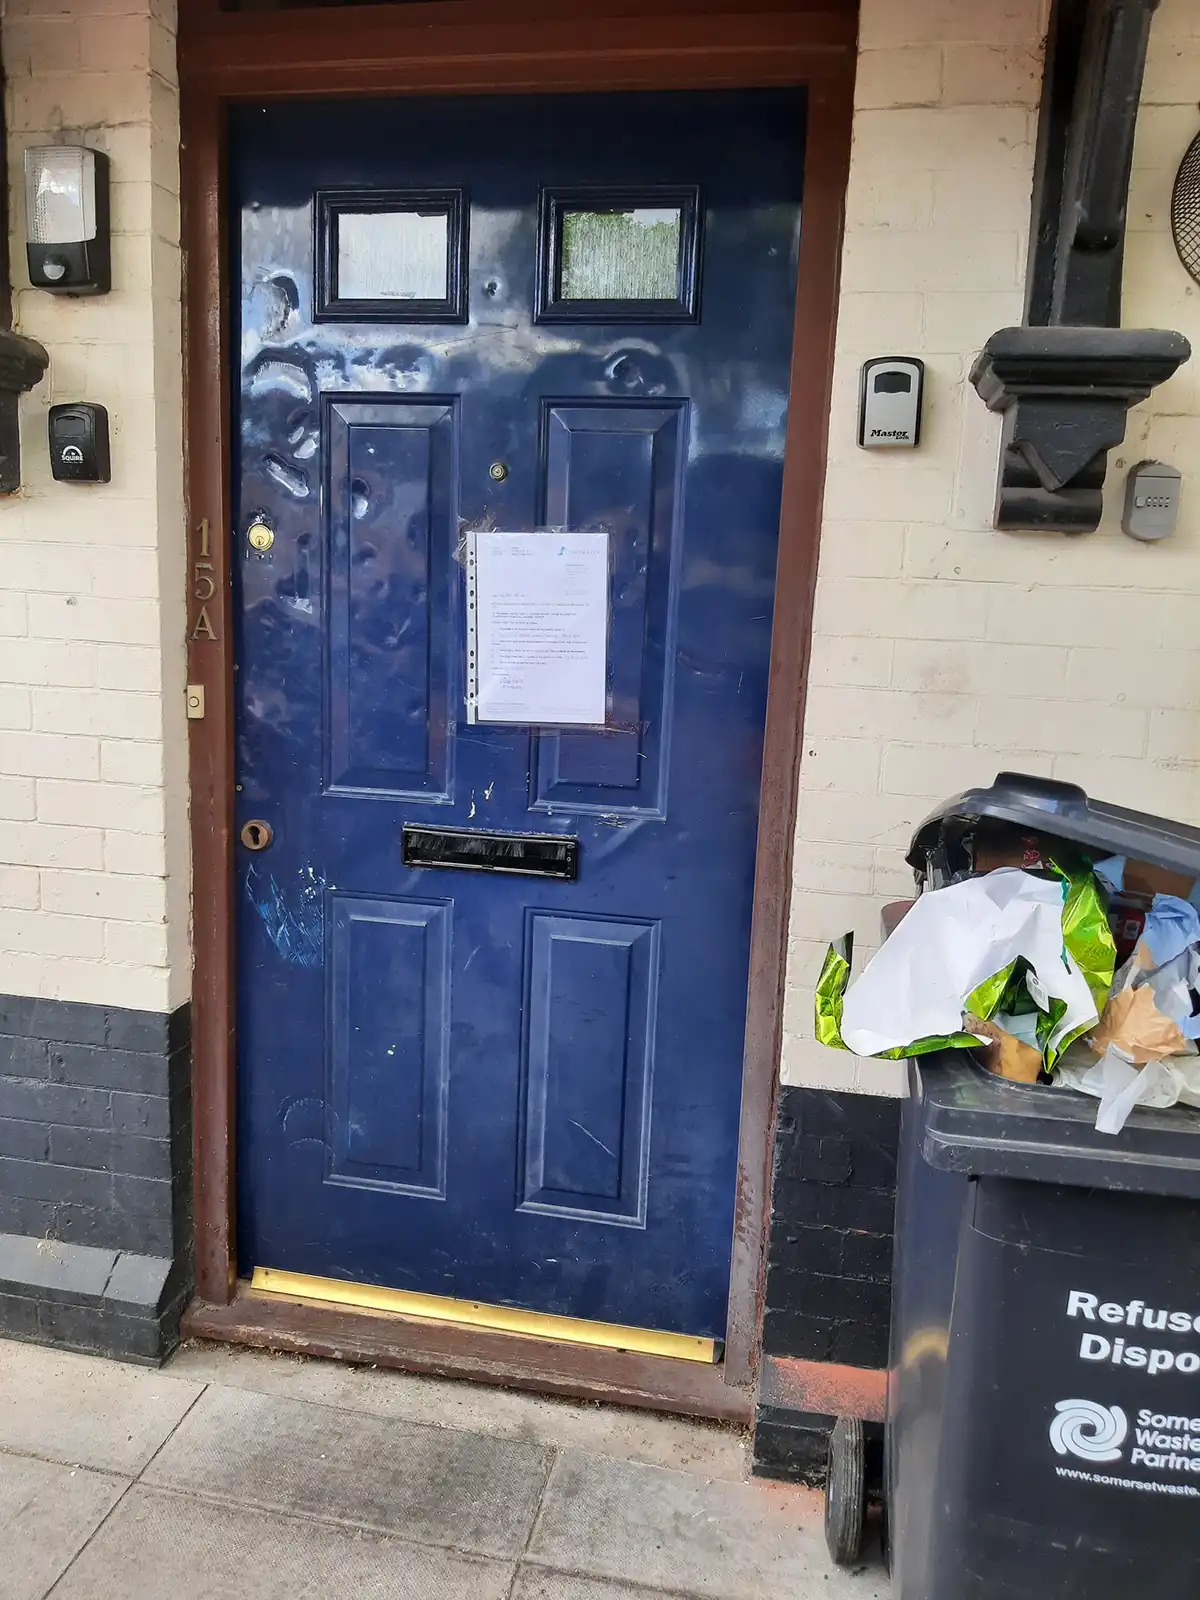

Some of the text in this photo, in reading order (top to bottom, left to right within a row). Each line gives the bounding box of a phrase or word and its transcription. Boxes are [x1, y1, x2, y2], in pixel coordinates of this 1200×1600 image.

[870, 429, 908, 437] Master
[189, 518, 219, 640] 15A
[1079, 1332, 1200, 1375] Dispo
[1136, 1408, 1200, 1432] Some
[1134, 1427, 1200, 1453] Waste
[1130, 1447, 1200, 1472] Partne
